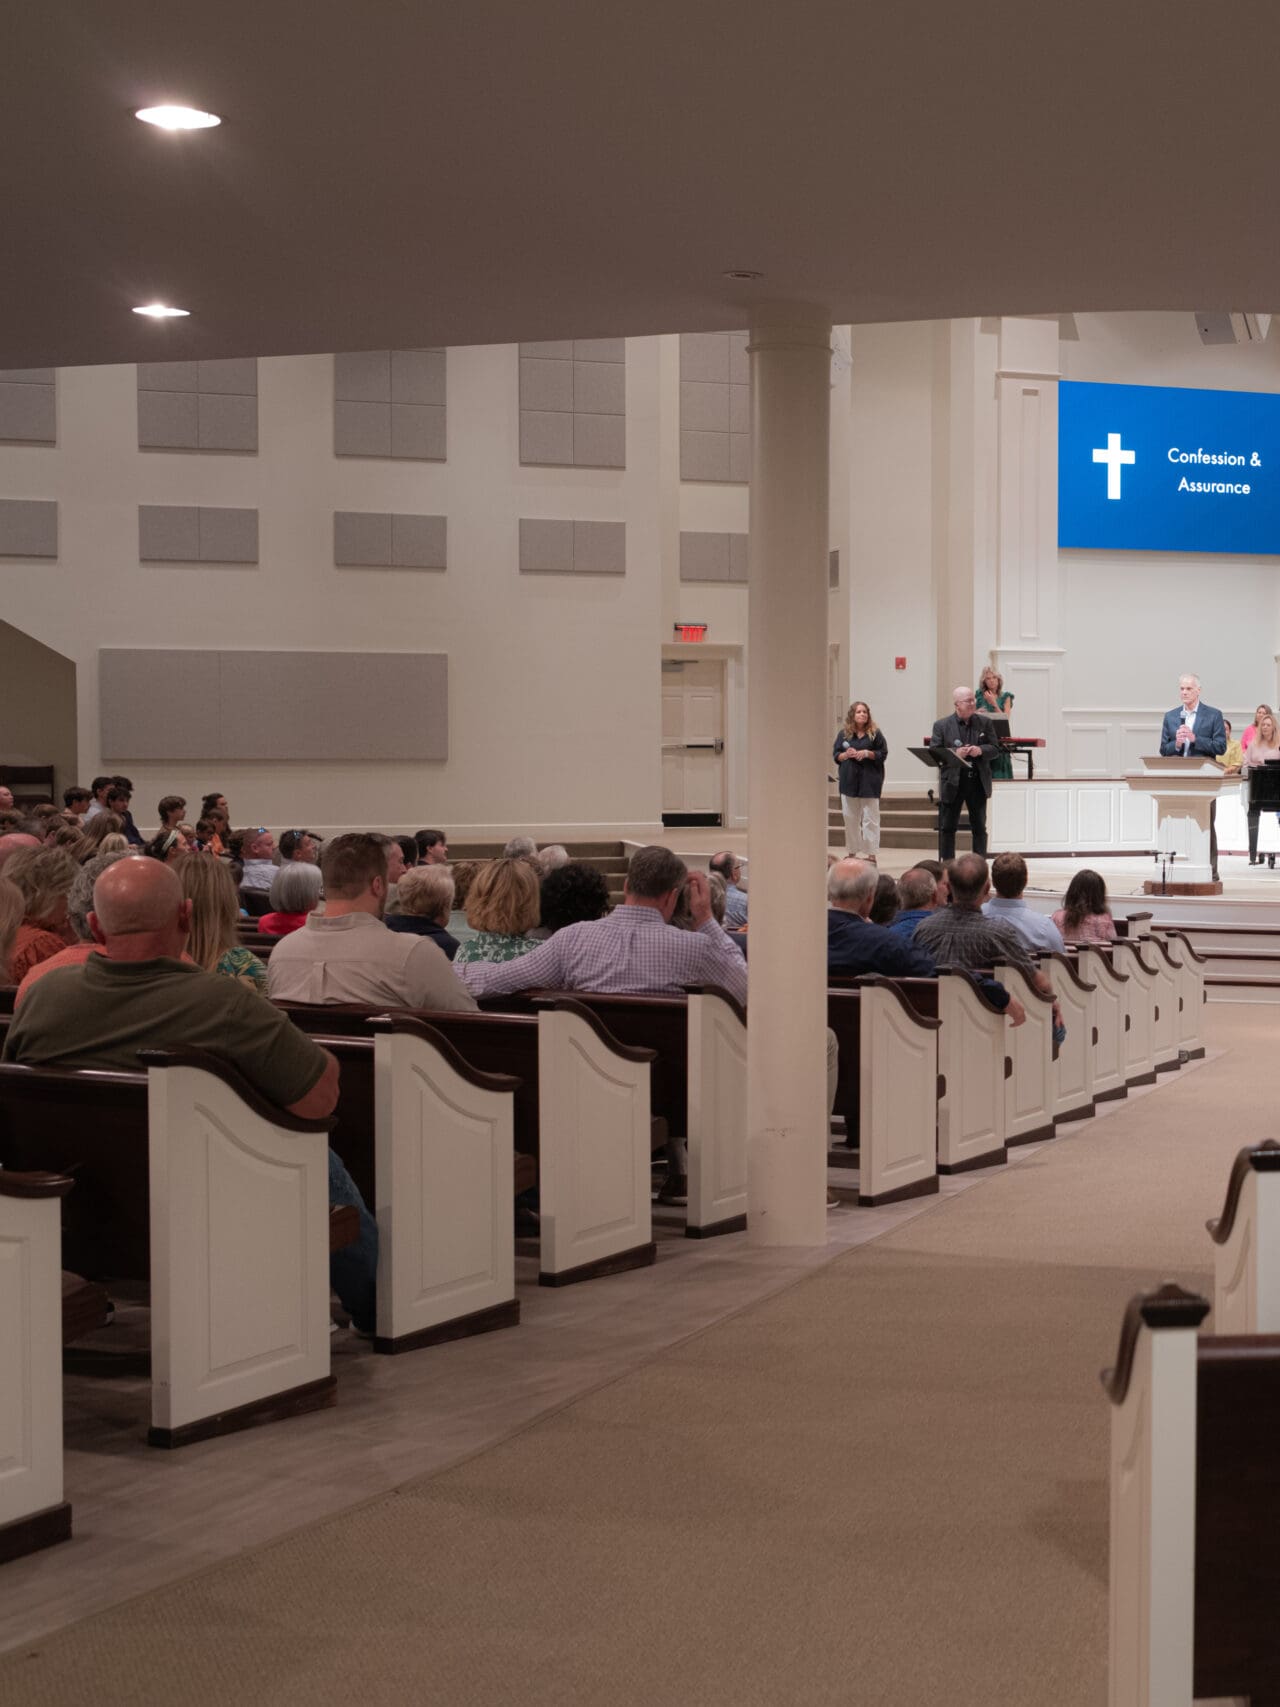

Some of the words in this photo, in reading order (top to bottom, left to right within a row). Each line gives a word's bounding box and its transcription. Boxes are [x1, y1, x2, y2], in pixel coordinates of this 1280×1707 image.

[1167, 447, 1246, 466] Confession
[1249, 451, 1262, 467] &
[1177, 476, 1251, 495] Assurance
